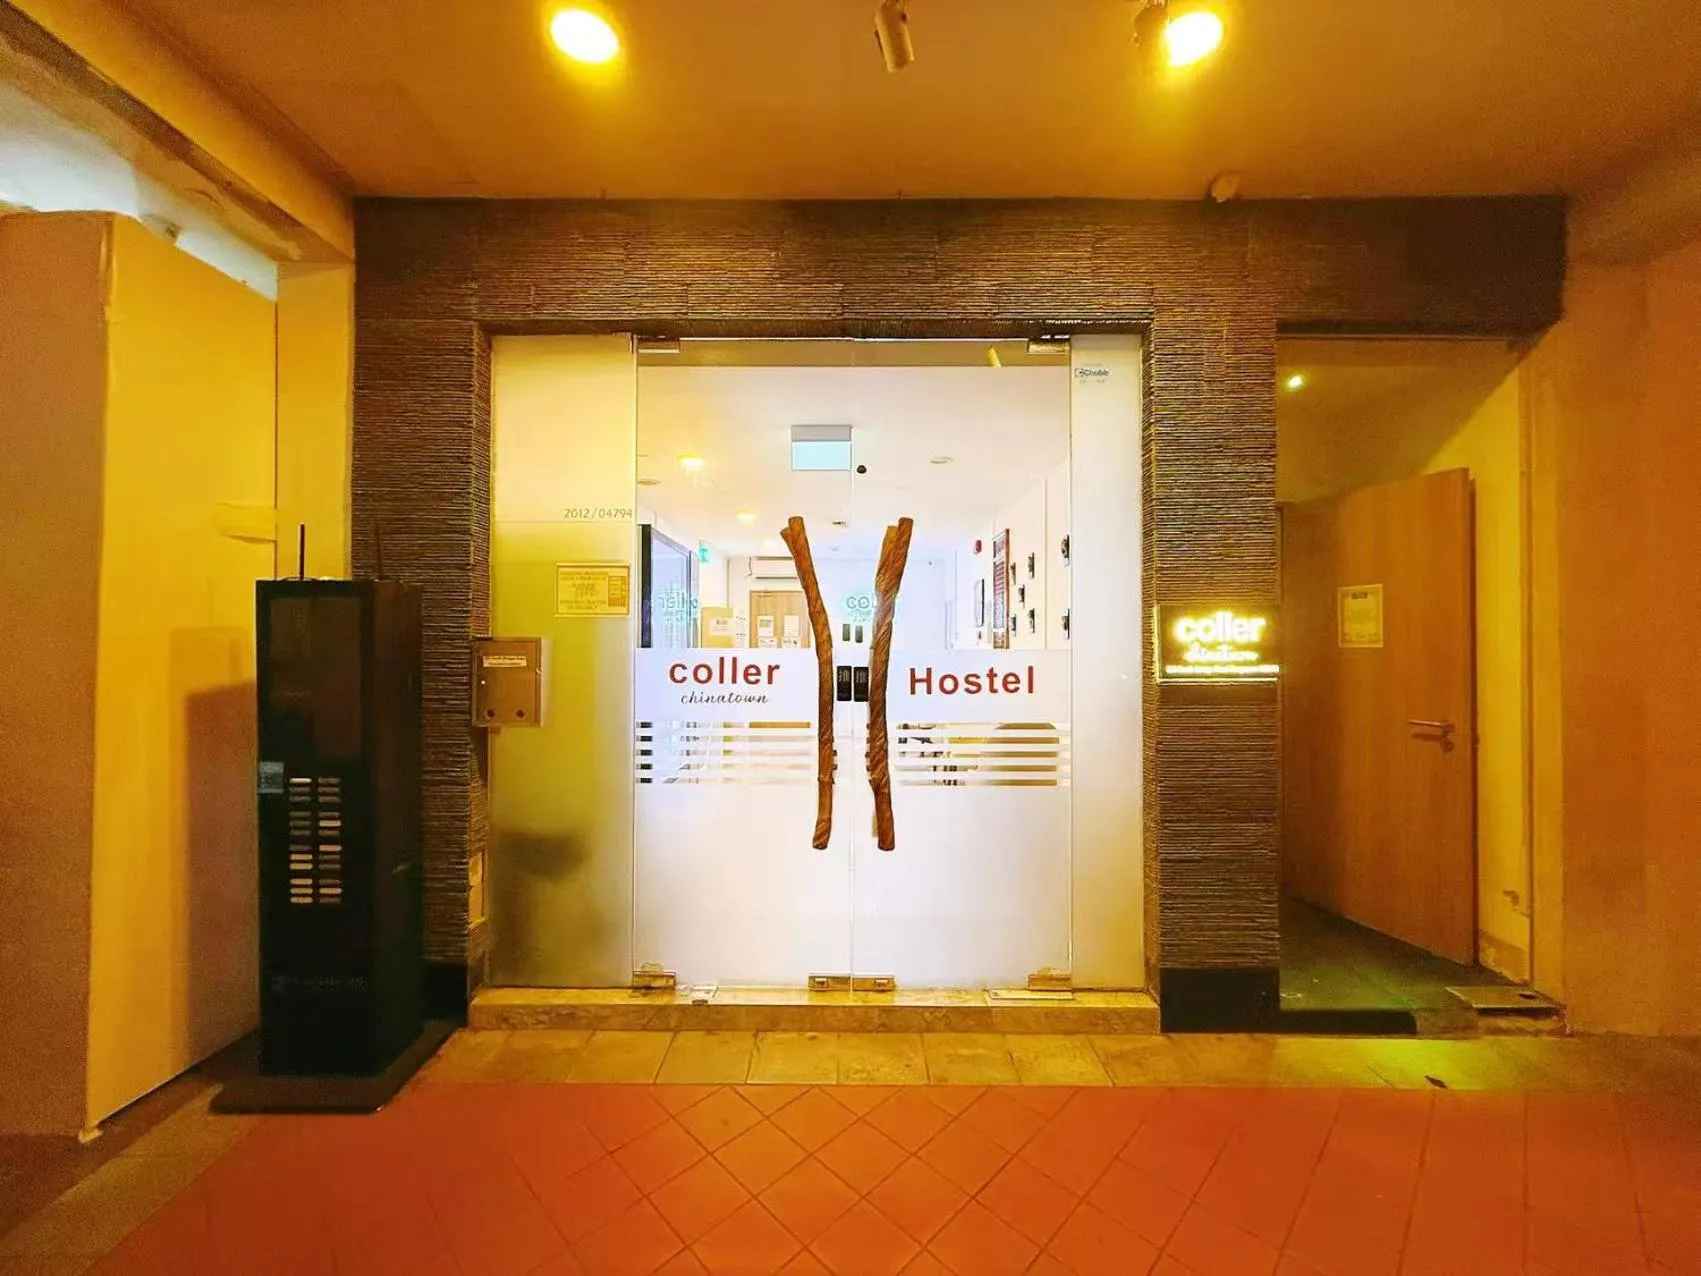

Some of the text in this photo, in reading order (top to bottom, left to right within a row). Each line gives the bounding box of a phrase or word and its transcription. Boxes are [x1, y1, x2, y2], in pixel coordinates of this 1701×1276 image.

[1174, 611, 1267, 643] coller
[669, 656, 780, 685] coller
[909, 665, 1034, 695] Hostel
[680, 691, 768, 704] chinatown
